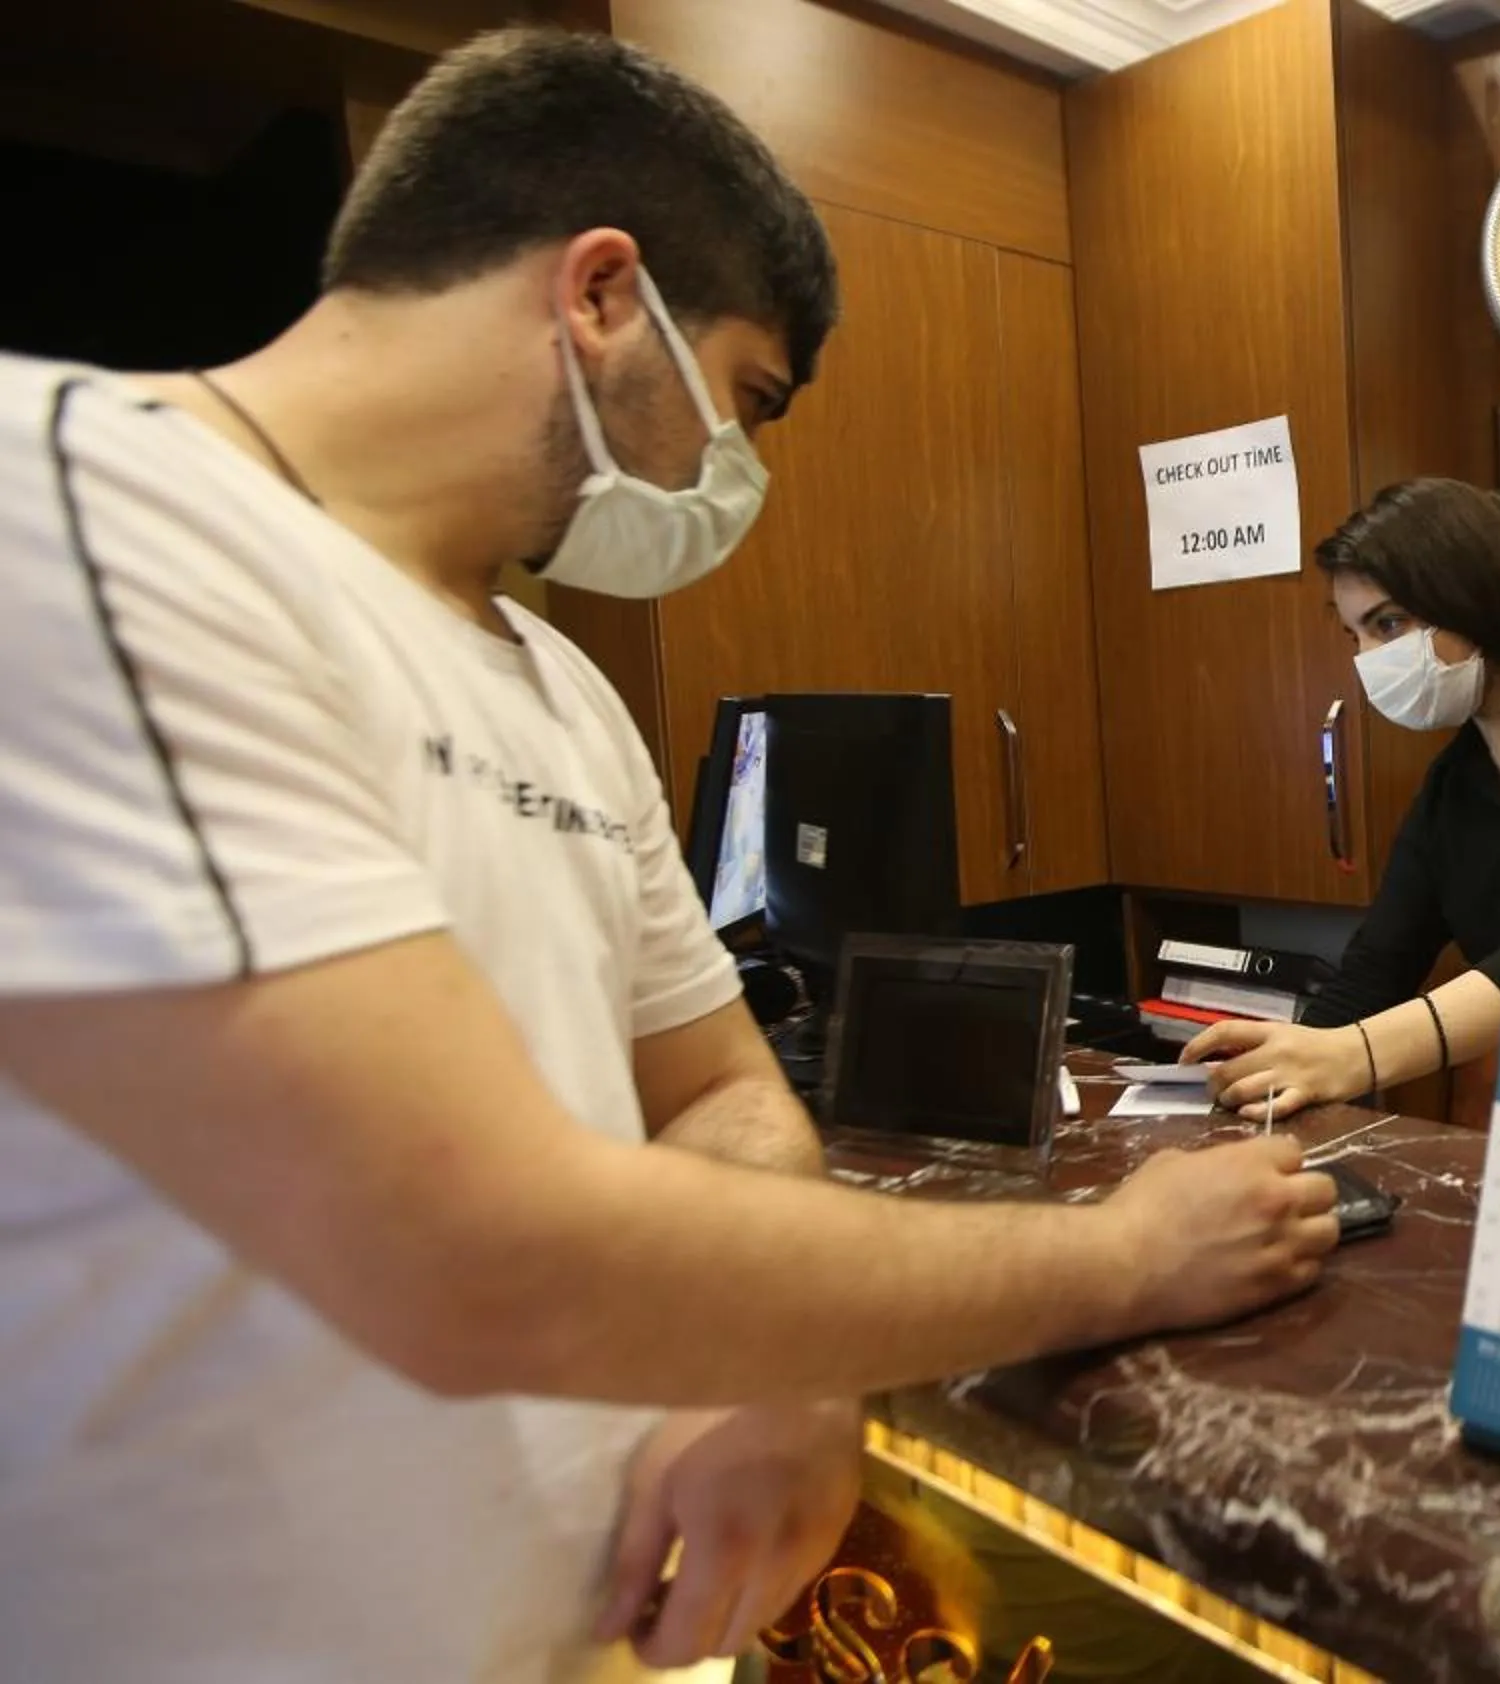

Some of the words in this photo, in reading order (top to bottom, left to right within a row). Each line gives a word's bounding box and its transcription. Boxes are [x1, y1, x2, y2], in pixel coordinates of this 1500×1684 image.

[1156, 461, 1203, 485] CHECK
[1207, 453, 1240, 475] OUT
[1181, 528, 1228, 554] 12:00
[1233, 523, 1265, 547] AM
